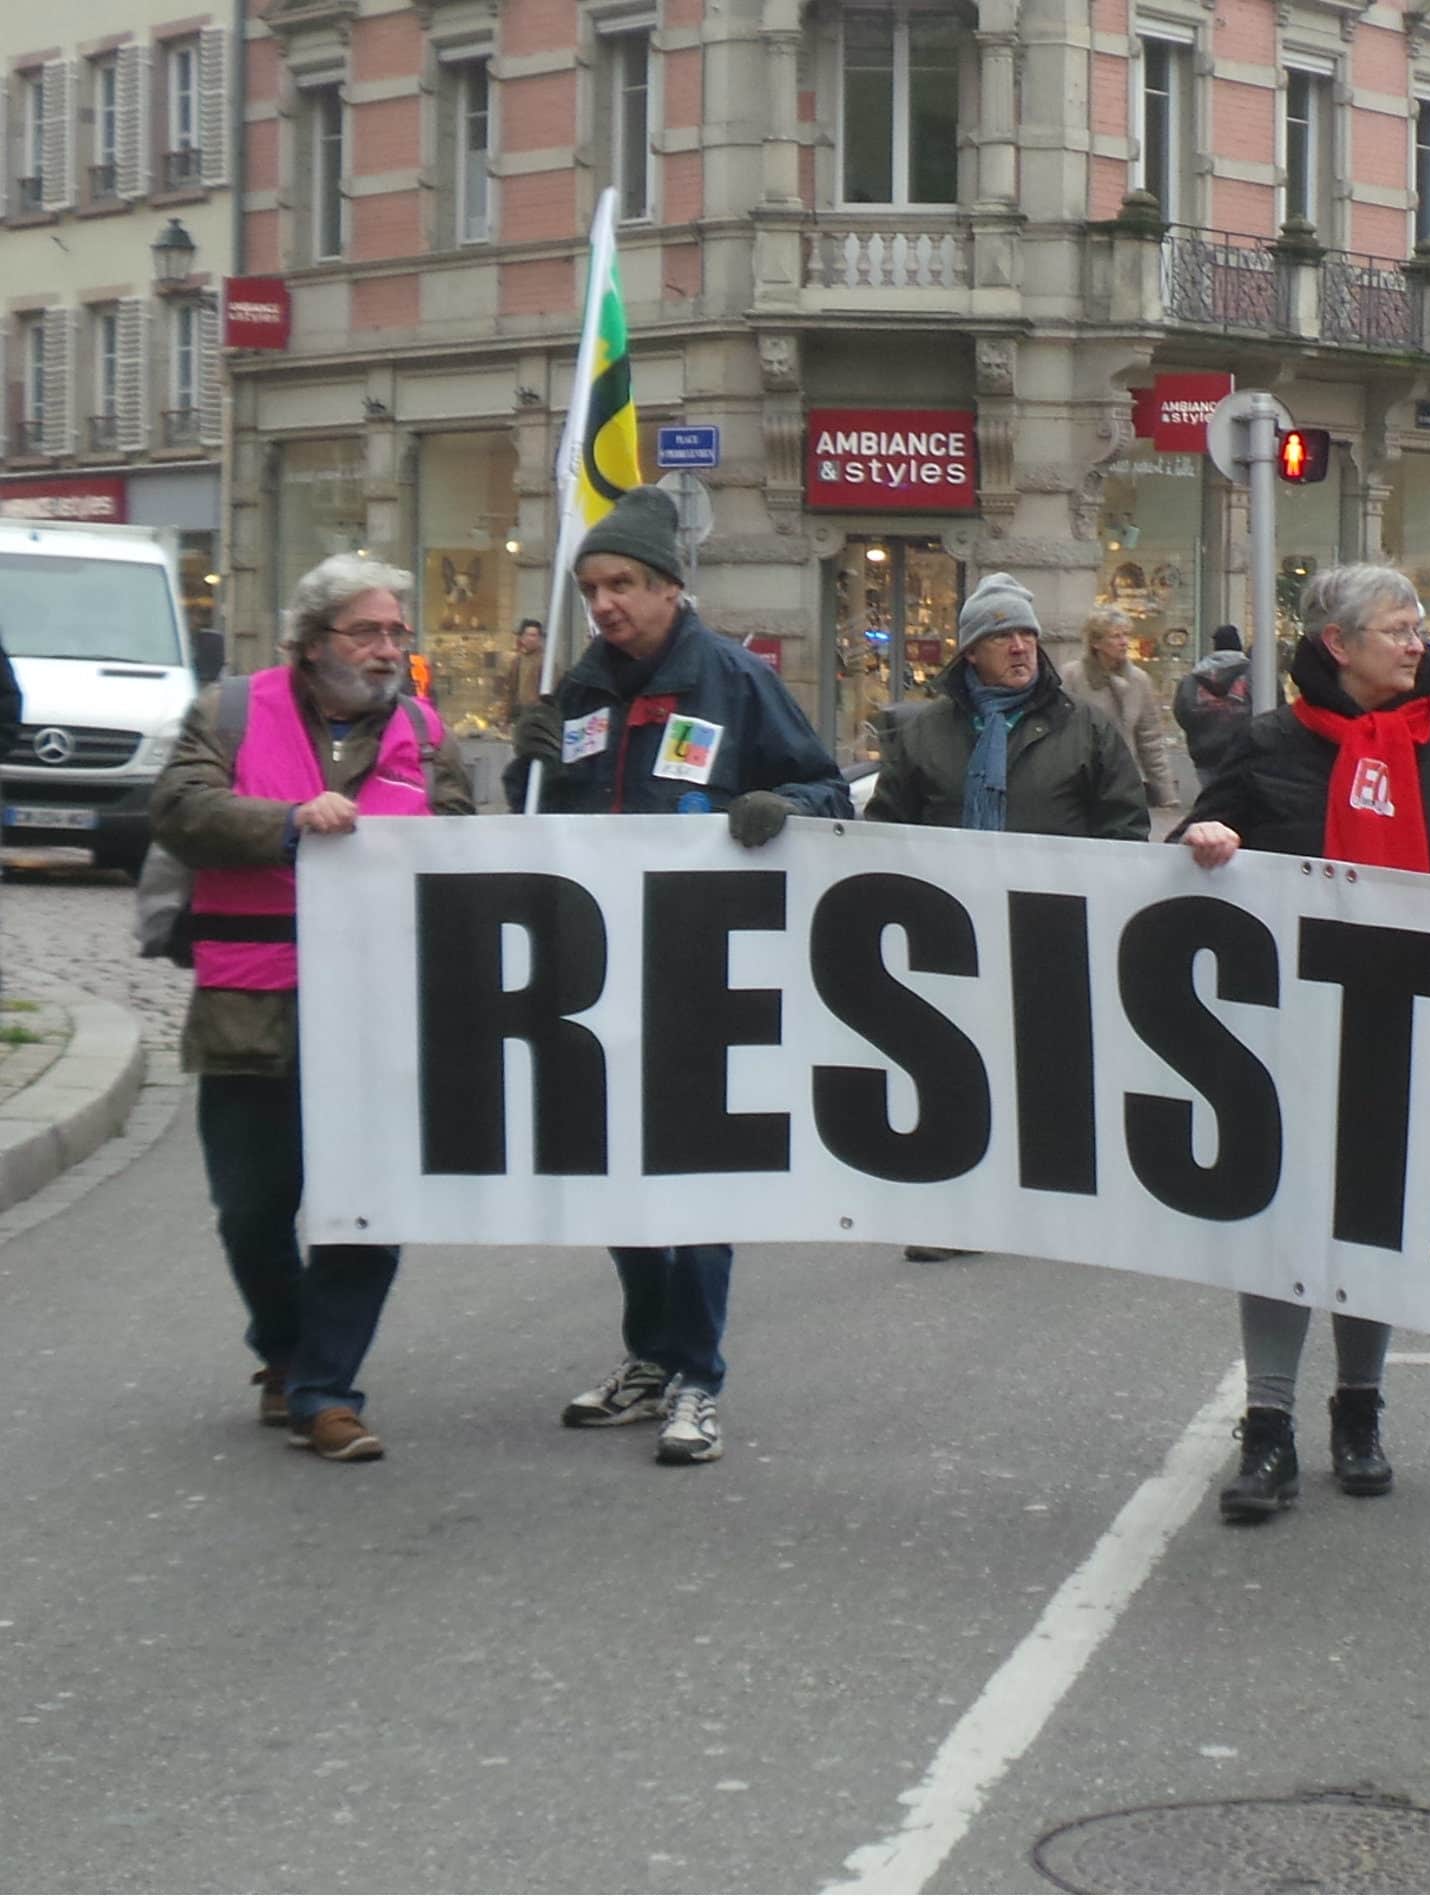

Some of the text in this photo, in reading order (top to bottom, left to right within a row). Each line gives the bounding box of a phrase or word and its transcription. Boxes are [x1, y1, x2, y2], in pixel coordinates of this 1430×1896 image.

[1161, 401, 1219, 412] AMBIANC
[1171, 412, 1215, 425] style
[816, 431, 966, 456] AMBIANCE
[820, 458, 967, 487] & styles
